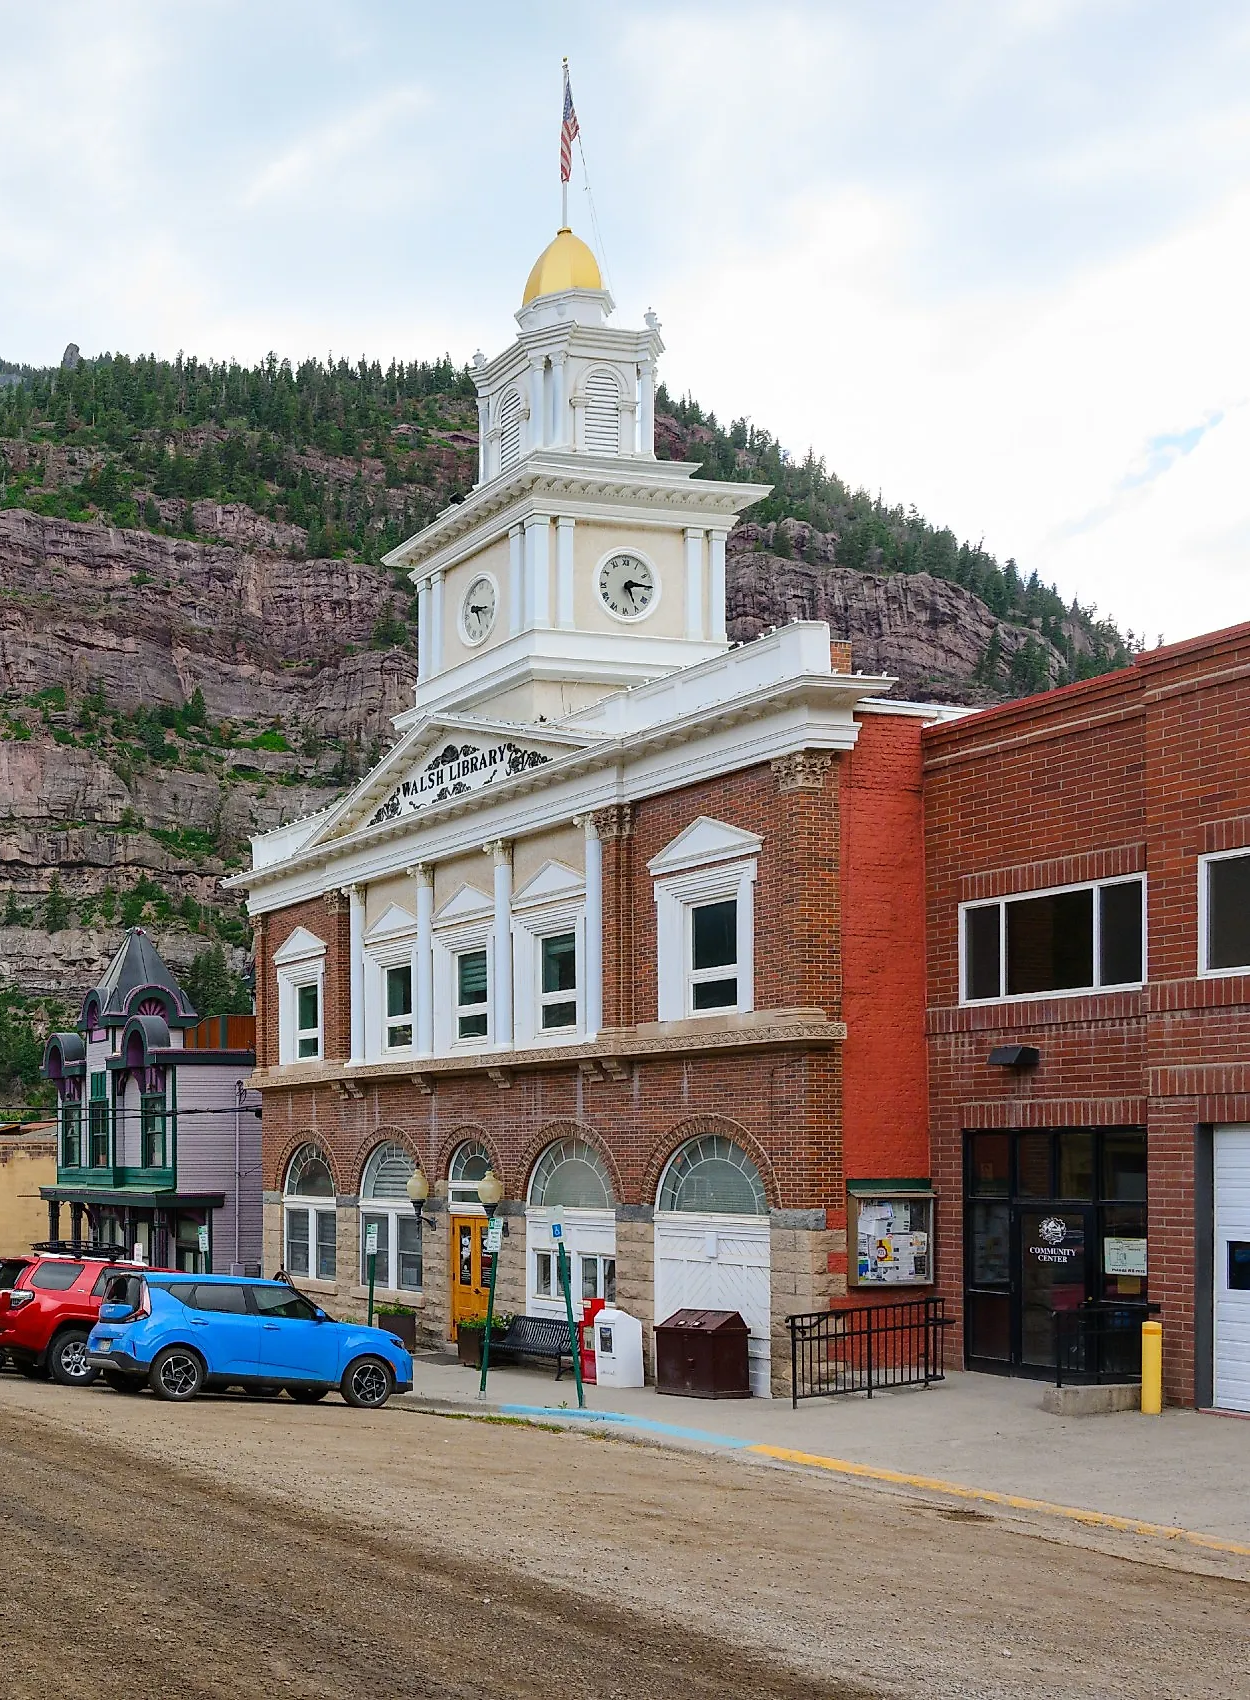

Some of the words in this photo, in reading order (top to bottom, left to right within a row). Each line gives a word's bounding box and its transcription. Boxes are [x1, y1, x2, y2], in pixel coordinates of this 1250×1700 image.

[401, 769, 444, 798] WALSH
[448, 743, 507, 782] LIBRARY
[1030, 1246, 1076, 1257] COMMUNITY
[1037, 1255, 1068, 1263] CENTER
